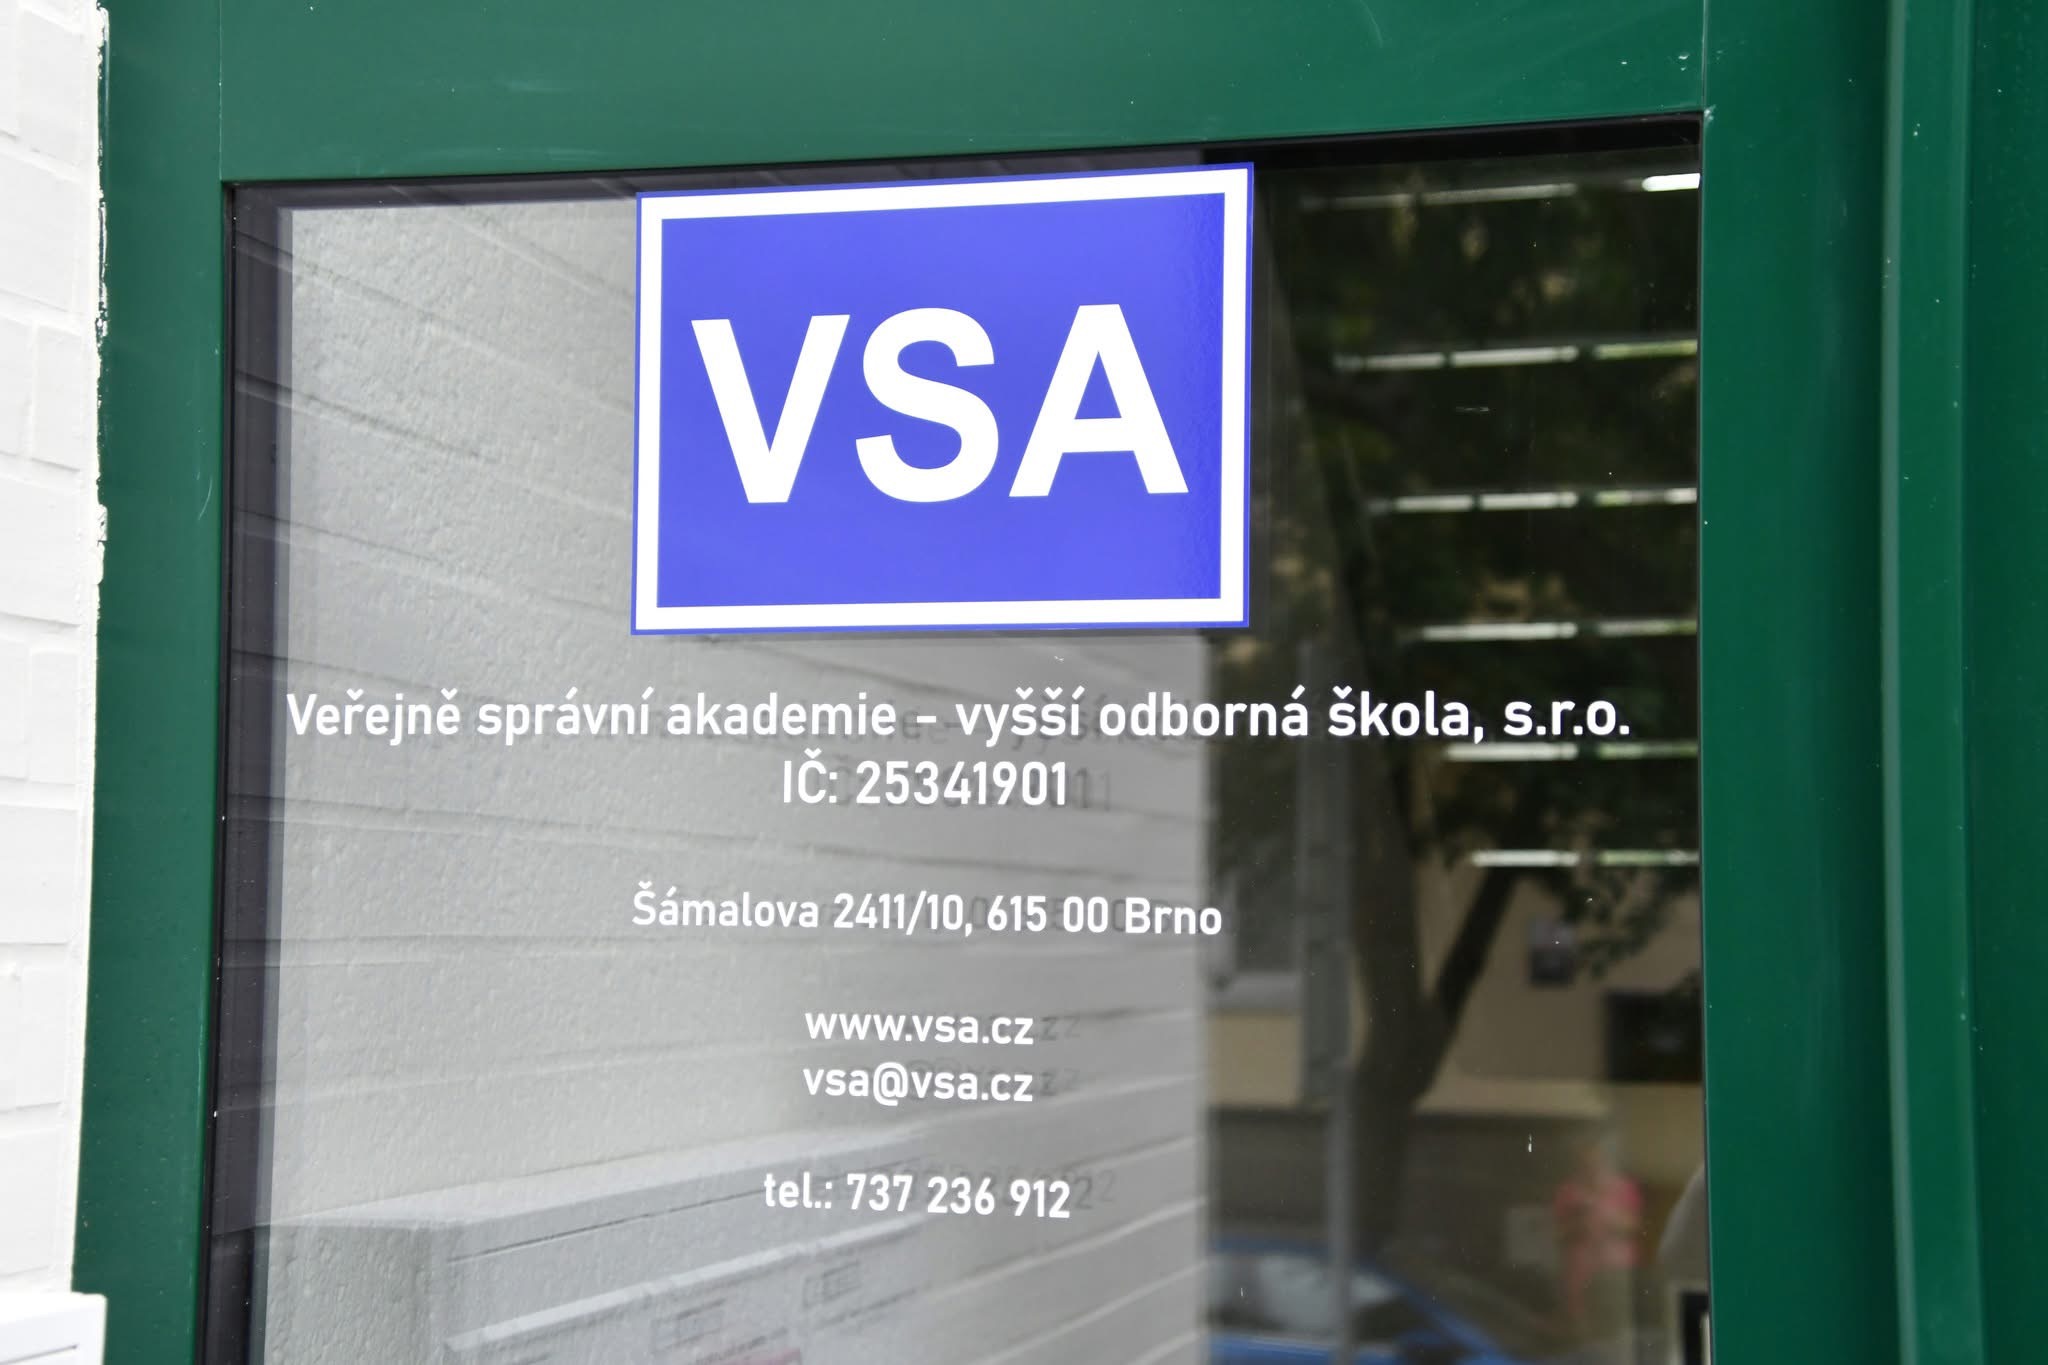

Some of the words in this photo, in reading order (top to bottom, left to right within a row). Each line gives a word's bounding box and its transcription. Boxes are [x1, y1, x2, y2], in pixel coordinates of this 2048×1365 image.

[691, 304, 1188, 503] VSA
[286, 687, 461, 746] Veřejně
[477, 686, 654, 746] správní
[667, 692, 896, 736] akademie
[955, 685, 1085, 748] vyšší
[1100, 685, 1308, 736] odborná
[1328, 686, 1483, 744] škola,
[1504, 701, 1629, 736] s.r.o.
[783, 748, 838, 804] IČ:
[856, 760, 1066, 806] 25341901
[631, 880, 819, 928] Šámalova
[833, 890, 972, 937] 2411/10,
[987, 895, 1047, 932] 615
[1063, 896, 1109, 933] 00
[1125, 897, 1222, 935] Brno
[804, 1012, 1034, 1045] www.vsa.cz
[802, 1062, 1033, 1106] vsa@vsa.cz
[763, 1171, 833, 1209] tel.:
[847, 1173, 913, 1212] 737
[927, 1176, 995, 1215] 236
[1010, 1179, 1070, 1219] 912
